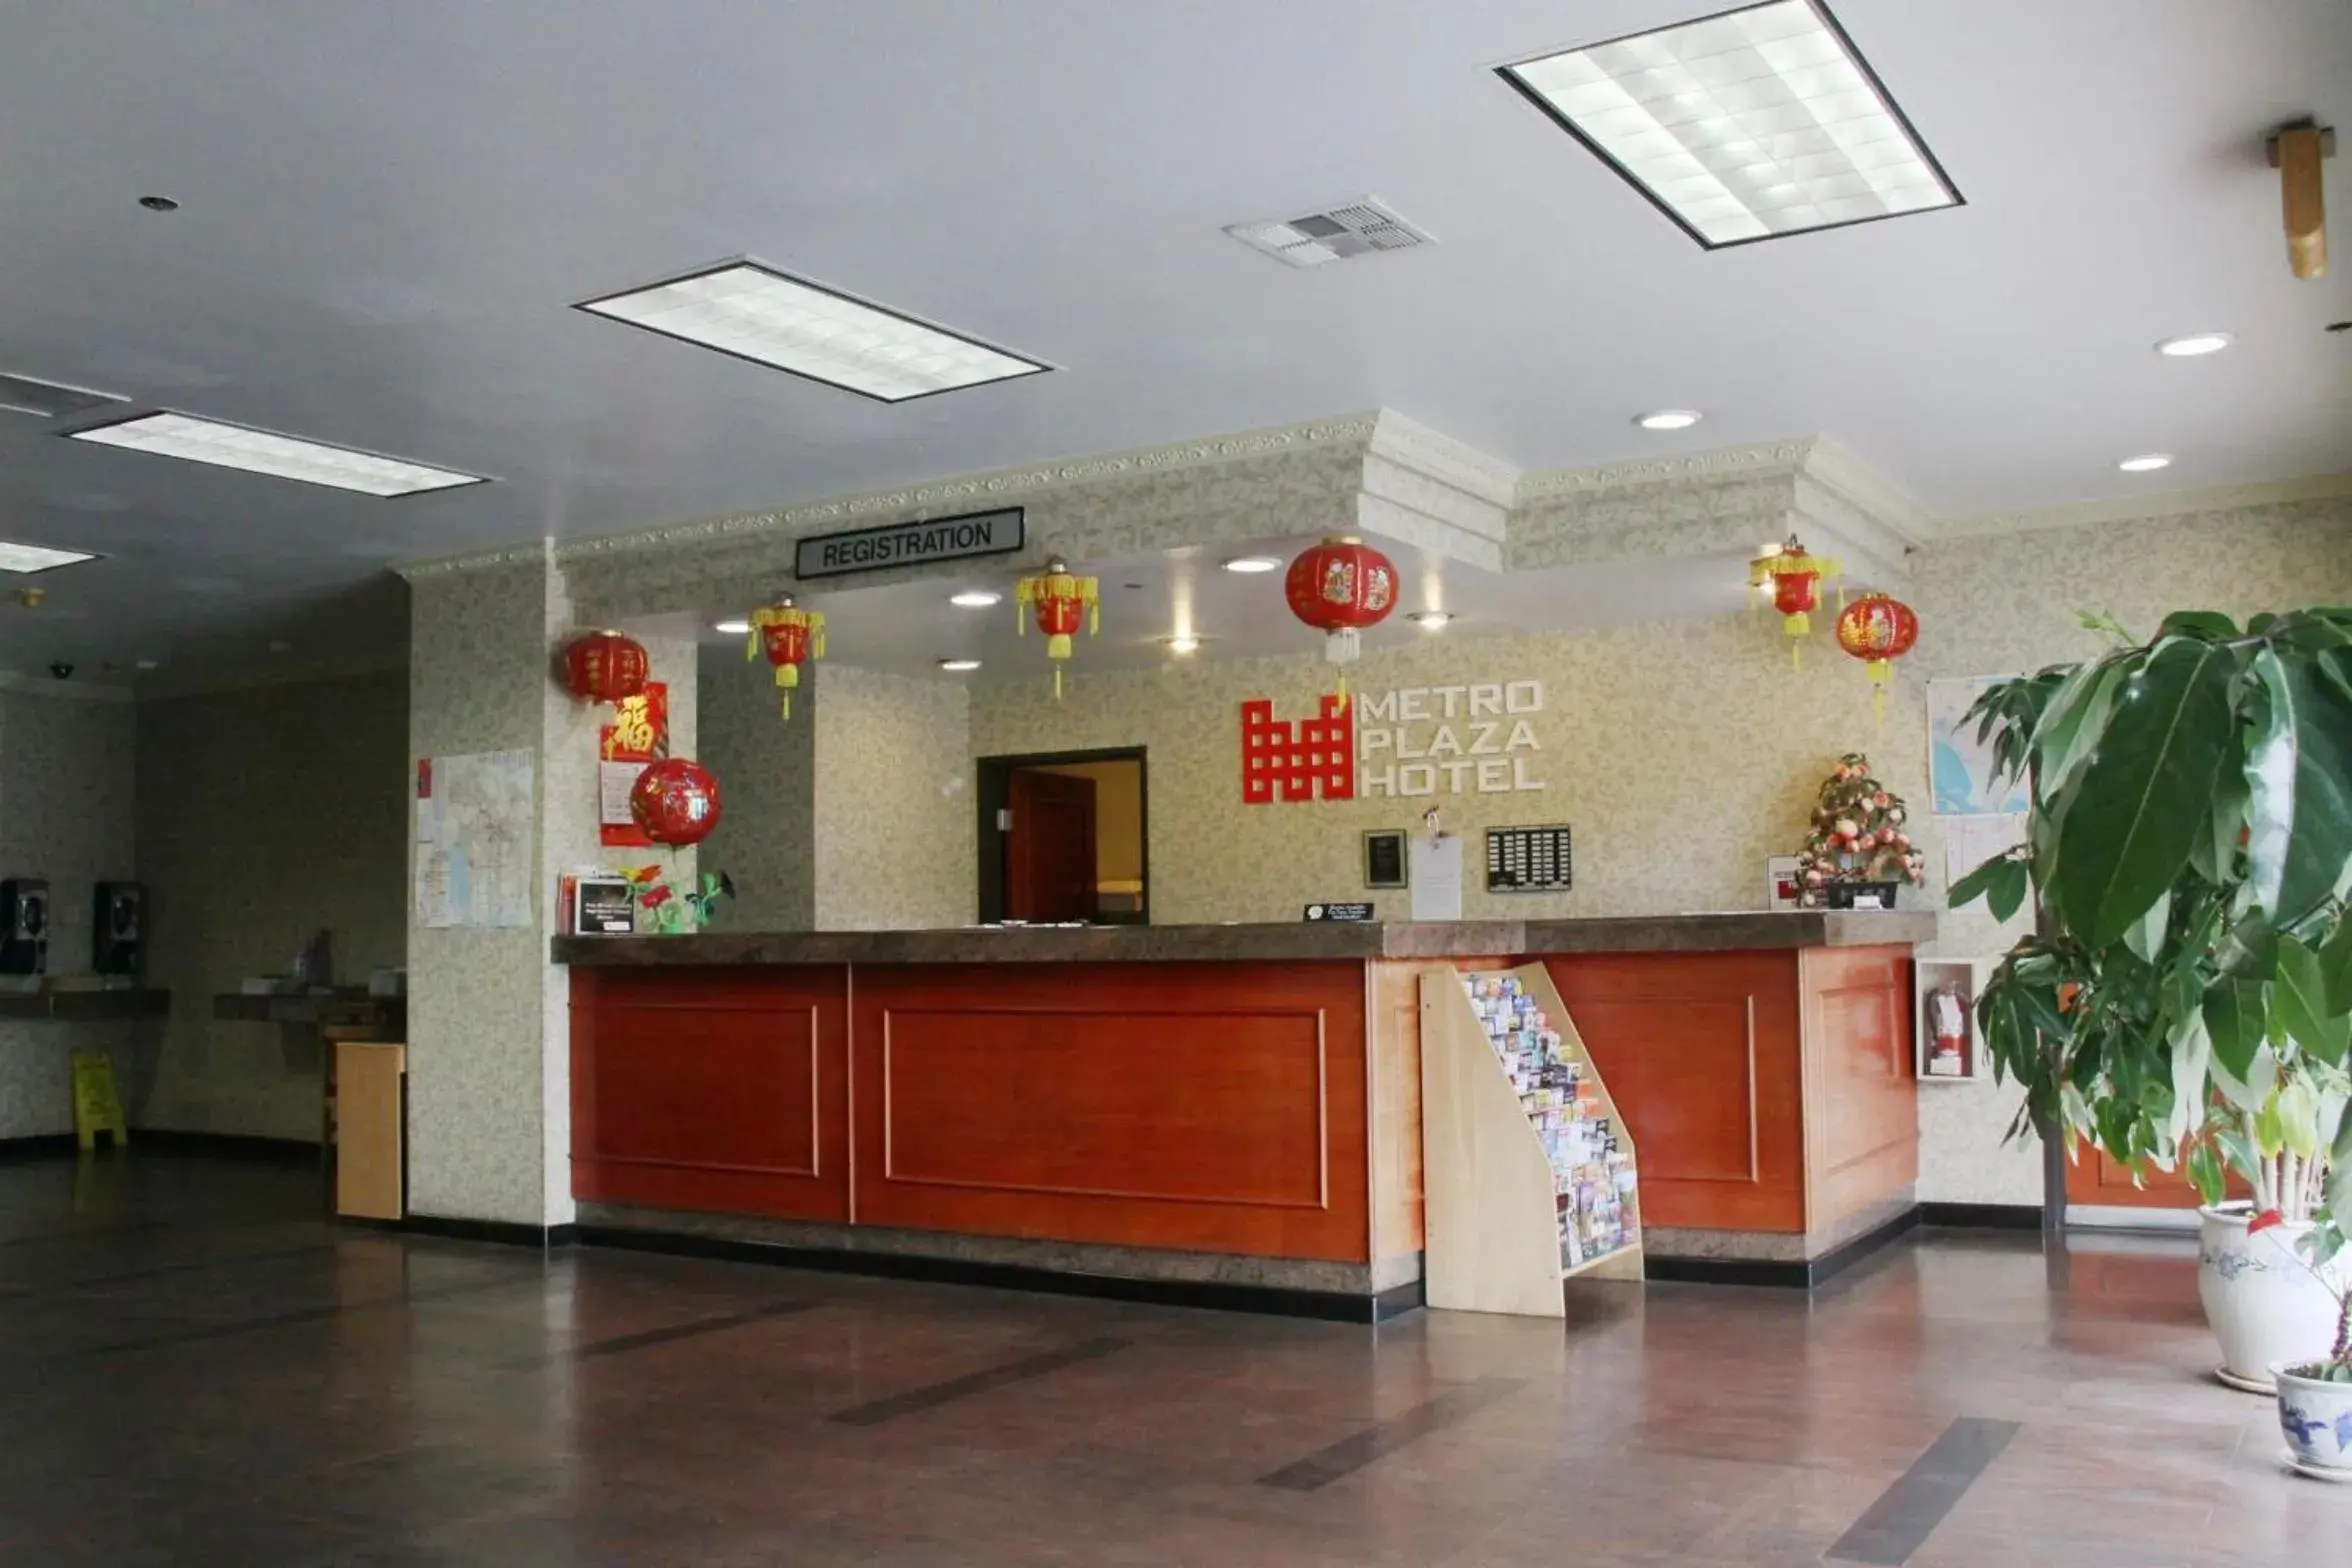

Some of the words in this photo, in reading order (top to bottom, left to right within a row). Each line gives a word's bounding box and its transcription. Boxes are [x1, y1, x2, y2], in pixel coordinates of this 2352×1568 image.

[823, 521, 992, 567] REGISTRATION
[1360, 680, 1544, 723] METRO
[1360, 720, 1542, 760] PLAZA
[1360, 758, 1545, 798] HOTEL
